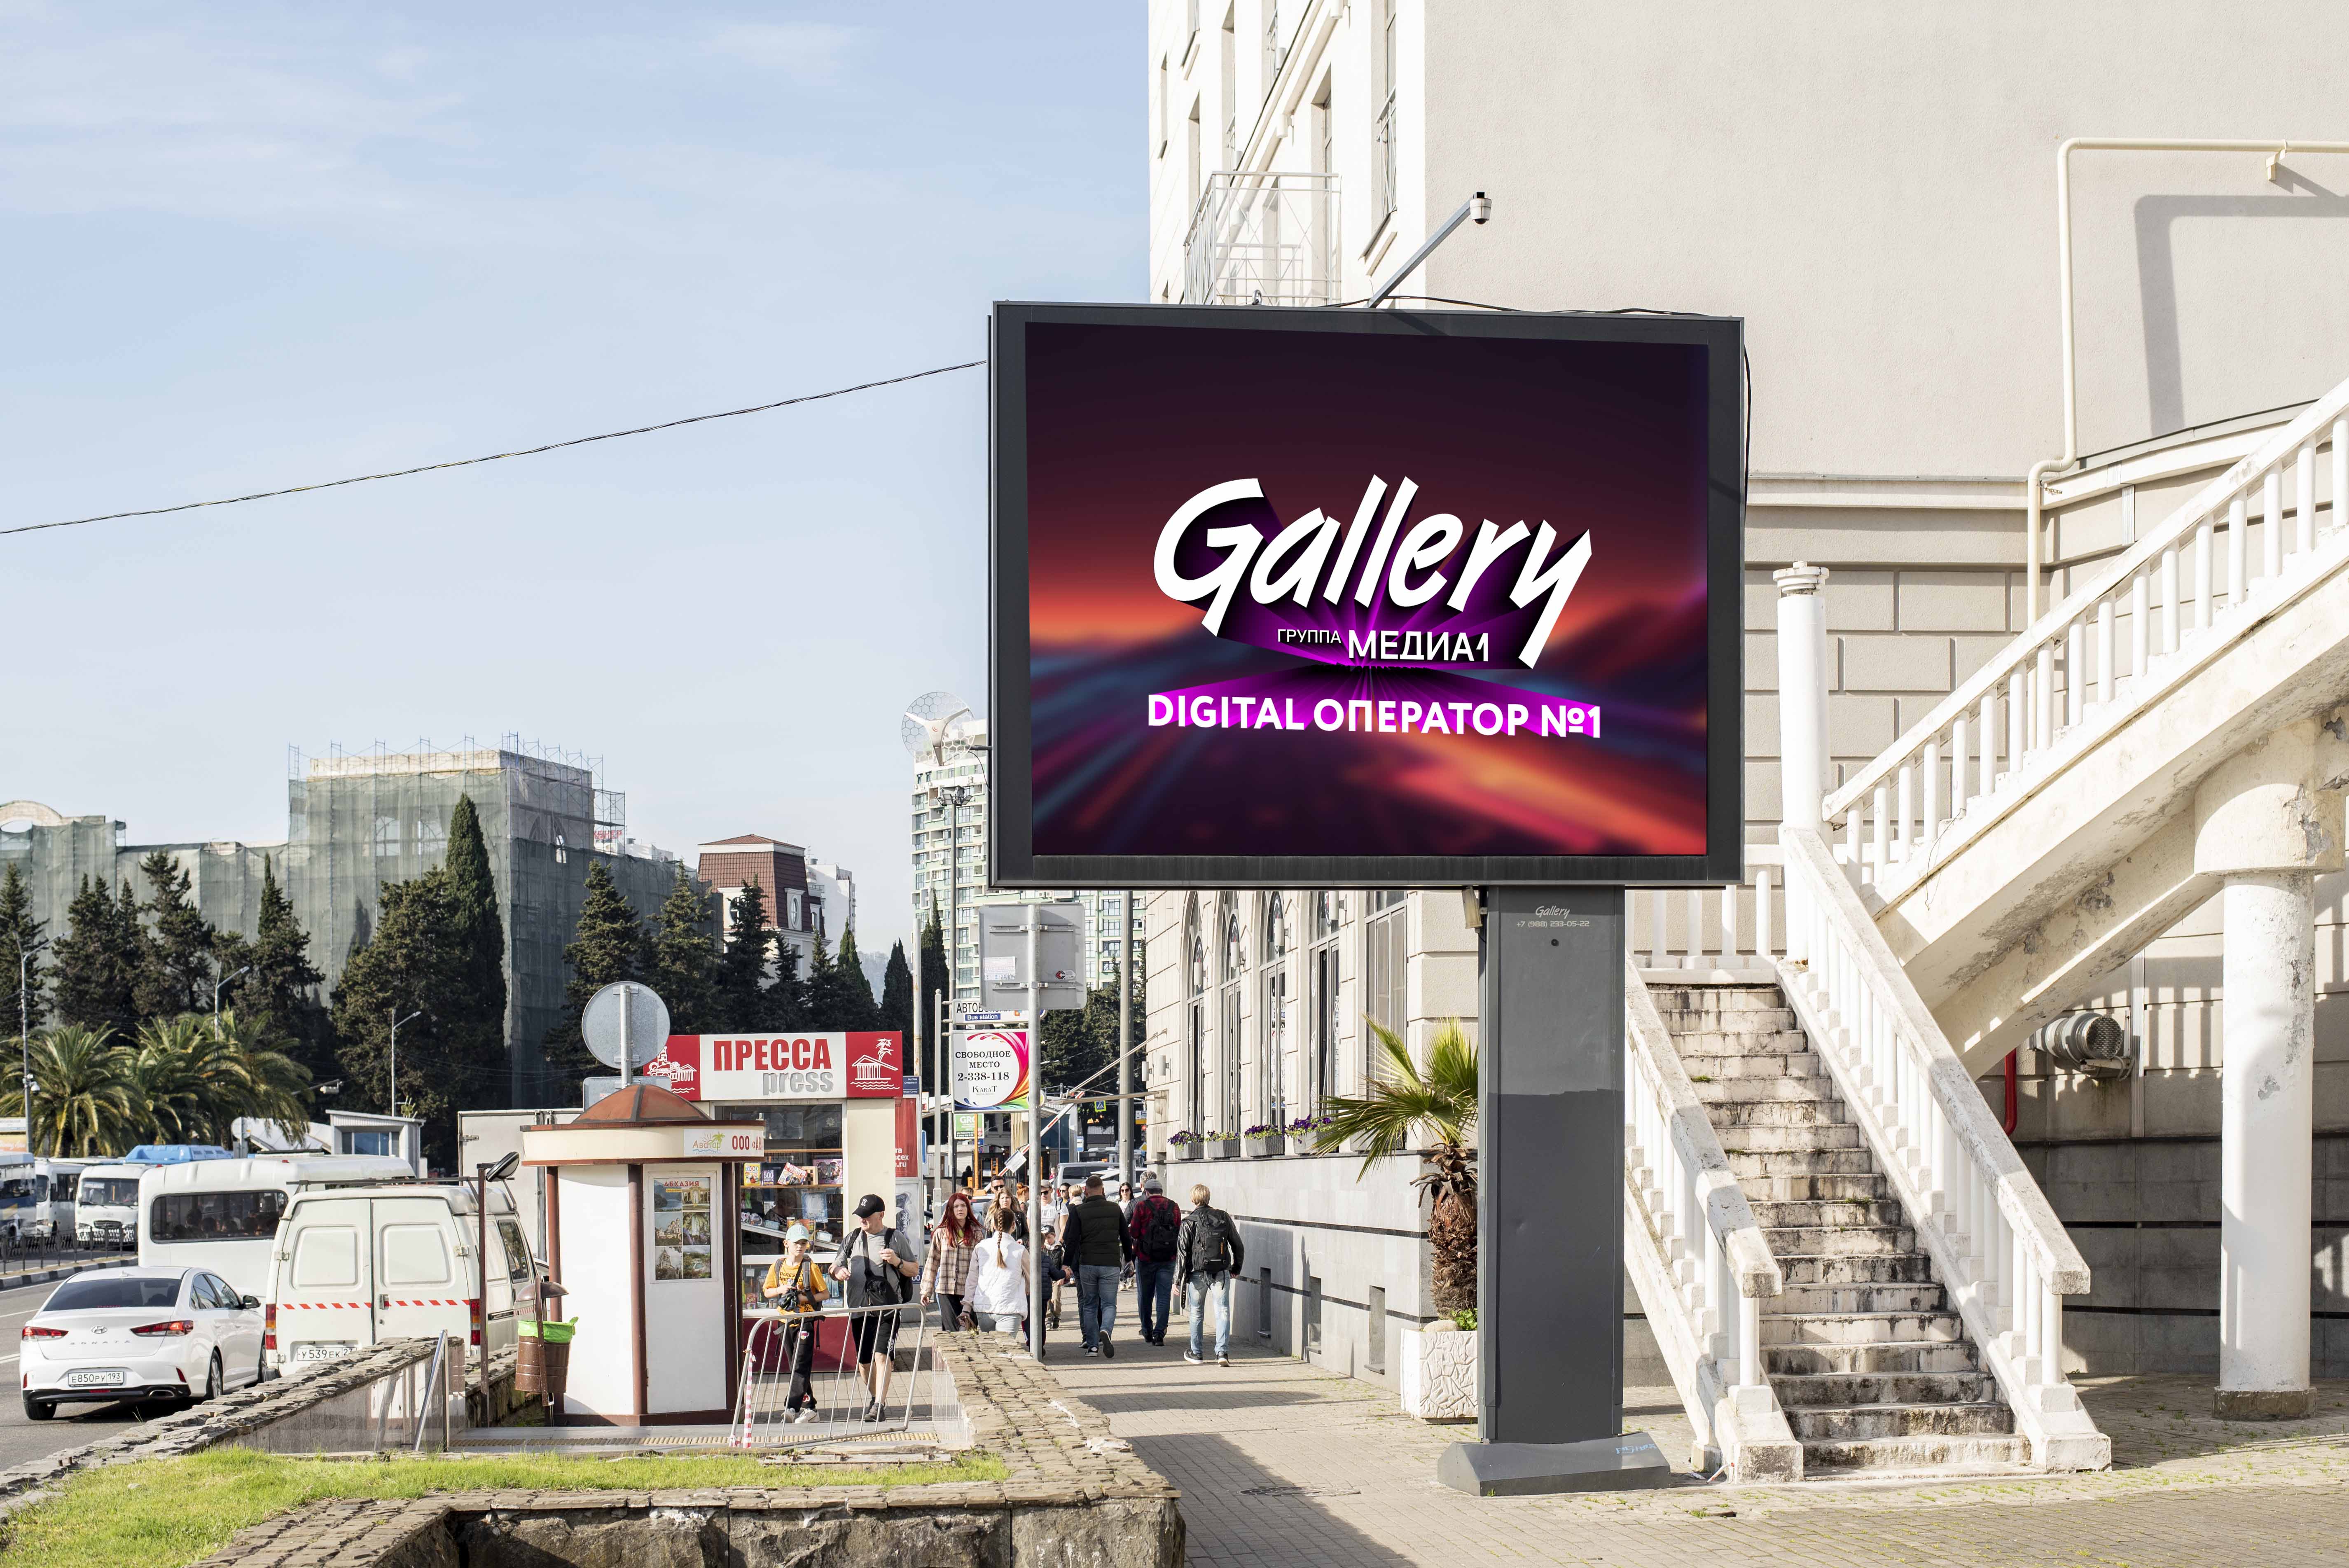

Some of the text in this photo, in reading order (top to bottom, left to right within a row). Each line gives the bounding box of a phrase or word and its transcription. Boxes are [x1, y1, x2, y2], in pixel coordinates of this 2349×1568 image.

[1153, 474, 1592, 669] Gallery
[1277, 629, 1342, 644] ГРУППА
[1148, 694, 1306, 731] DIGITAL
[1313, 699, 1529, 737] ОПЕРАТОР
[1535, 906, 1570, 919] Gallery
[713, 1038, 832, 1071] ПРЕССА
[762, 1072, 834, 1096] press
[958, 1072, 1010, 1081] 2-338-118
[692, 1140, 721, 1149] Аватар
[732, 1136, 750, 1150] ООО
